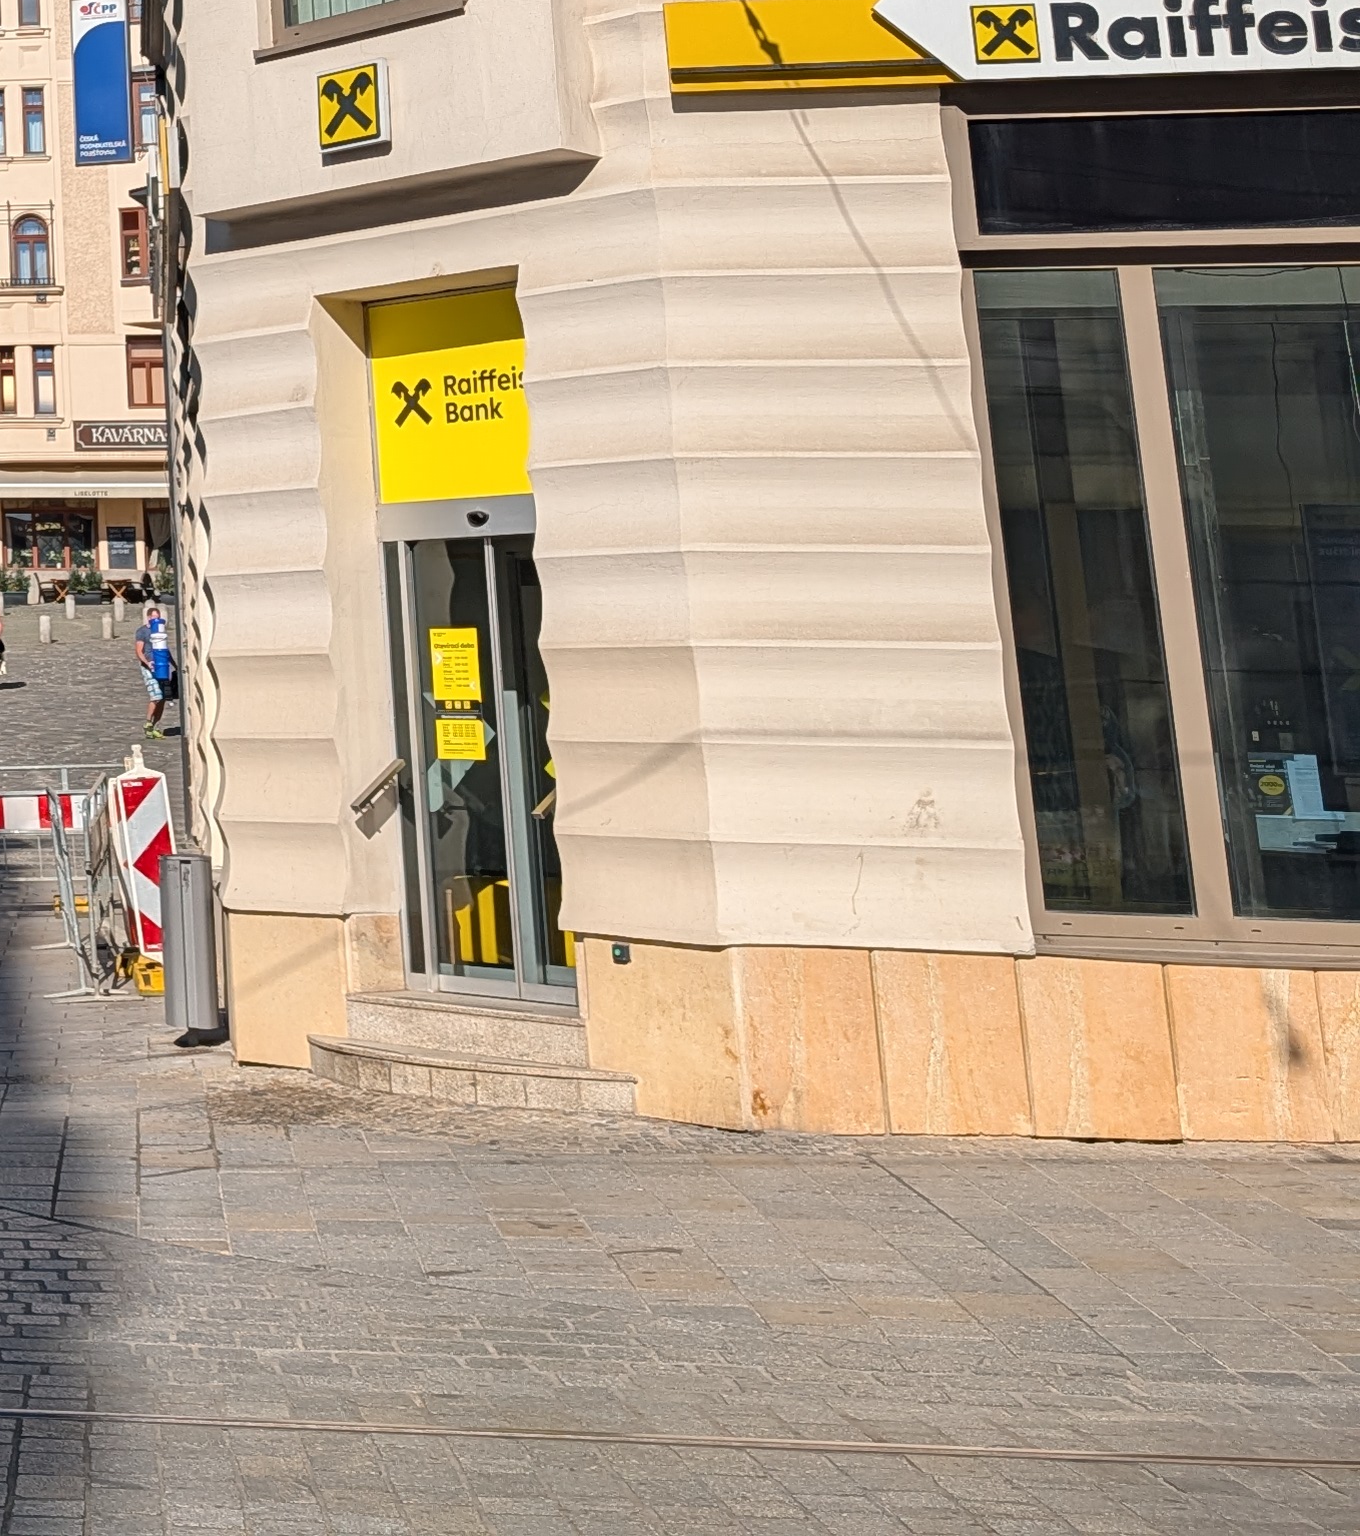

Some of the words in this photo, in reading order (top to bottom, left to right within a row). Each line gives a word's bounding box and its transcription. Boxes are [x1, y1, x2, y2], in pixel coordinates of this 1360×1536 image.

[93, 1, 117, 15] ČPP
[445, 396, 504, 425] Bank
[91, 426, 167, 445] KAVÁRNA
